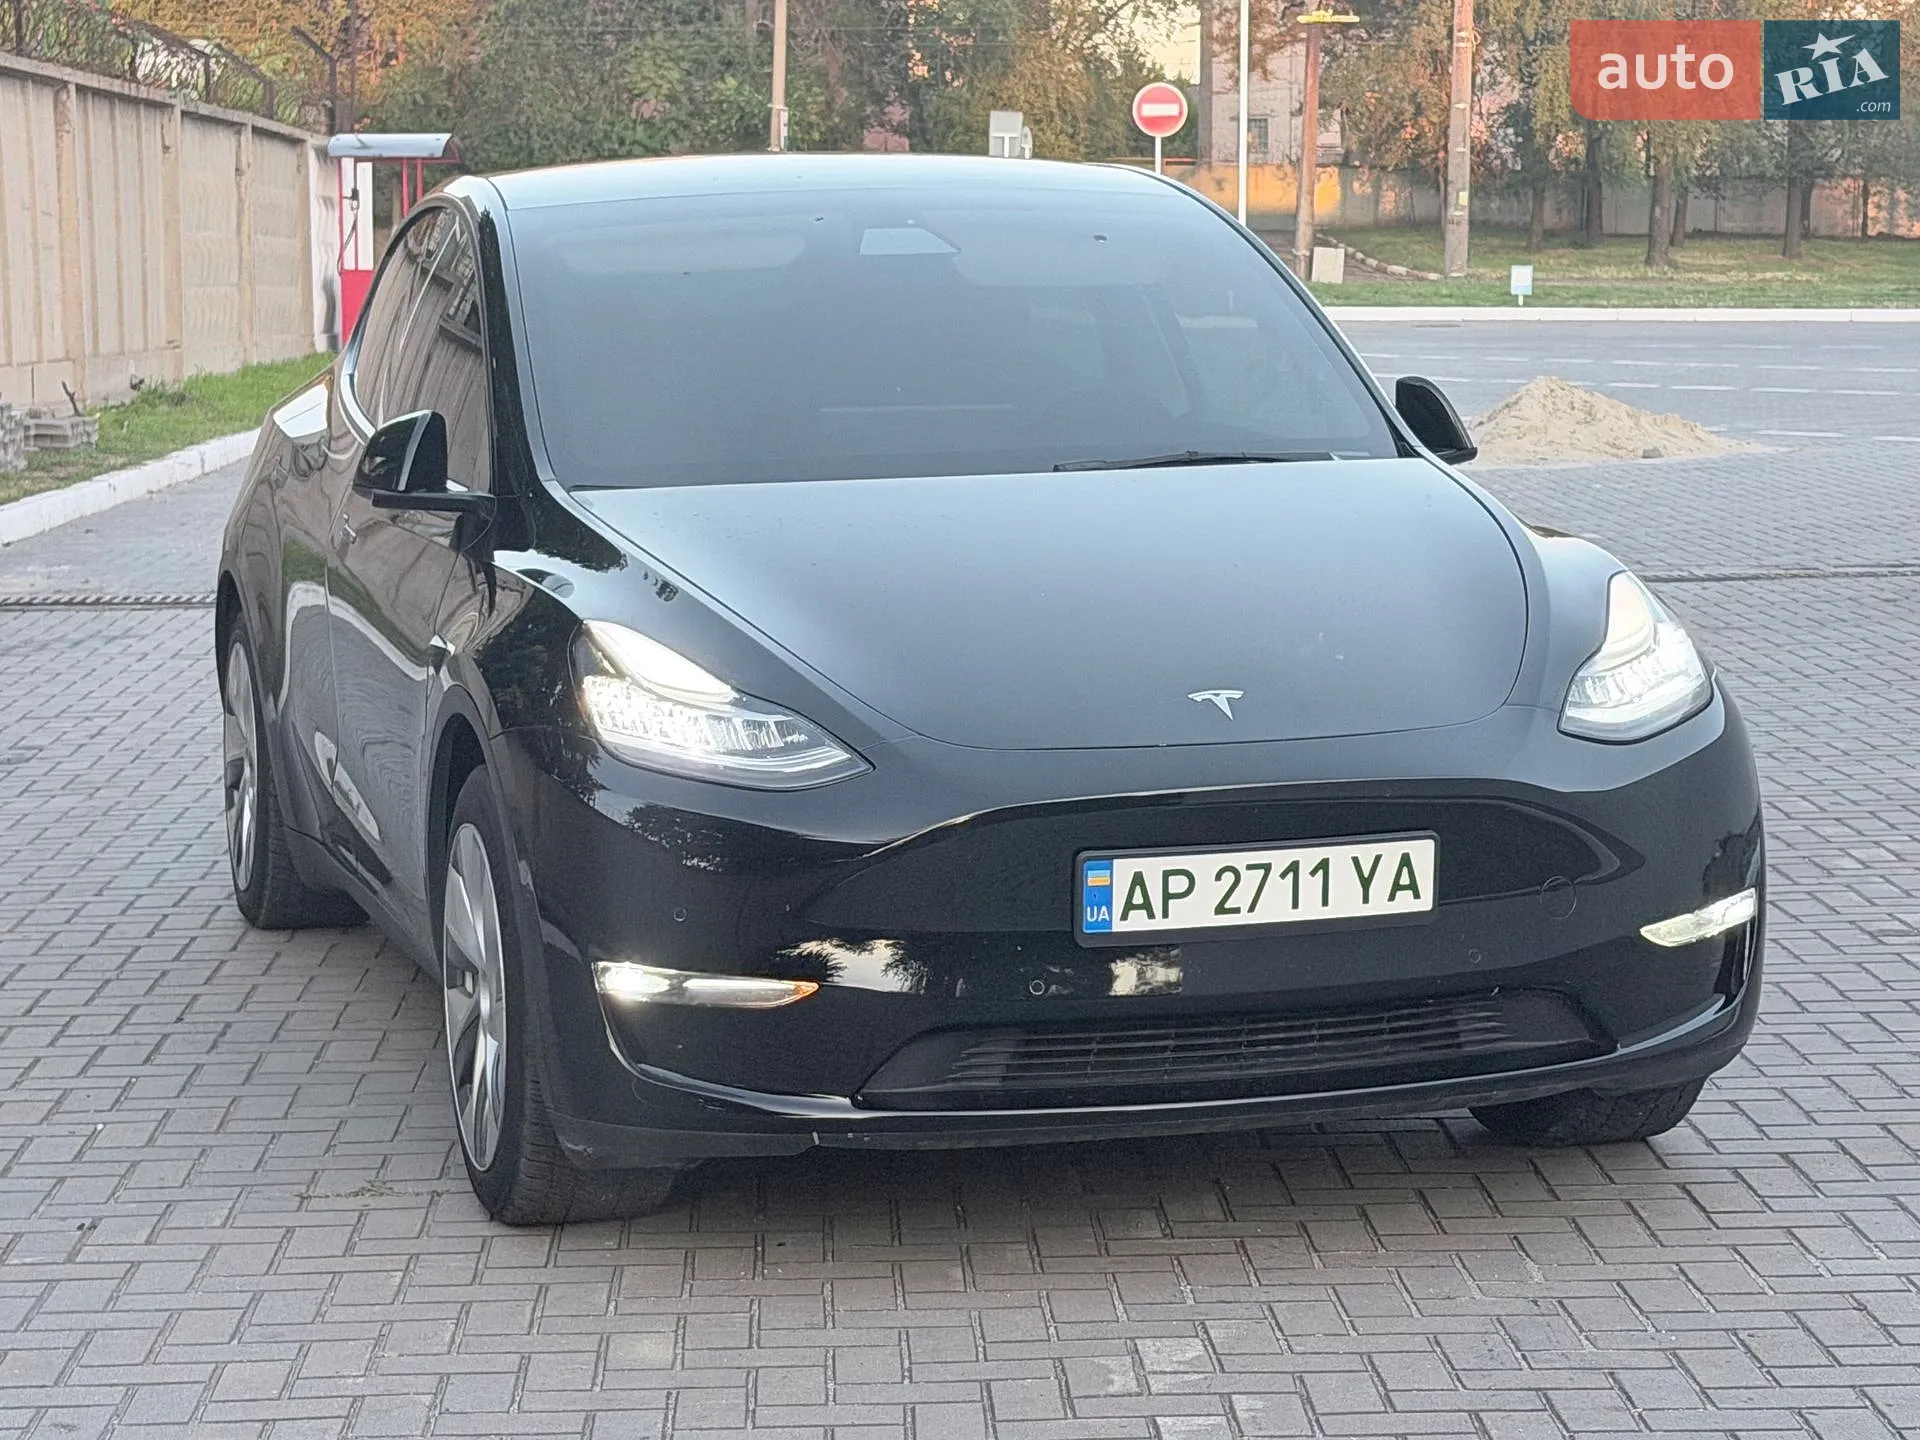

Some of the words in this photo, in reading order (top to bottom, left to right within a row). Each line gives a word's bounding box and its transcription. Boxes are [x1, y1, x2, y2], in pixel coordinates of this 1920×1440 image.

[1119, 869, 1196, 922] AP
[1213, 857, 1331, 916] 2711
[1086, 906, 1110, 923] UA
